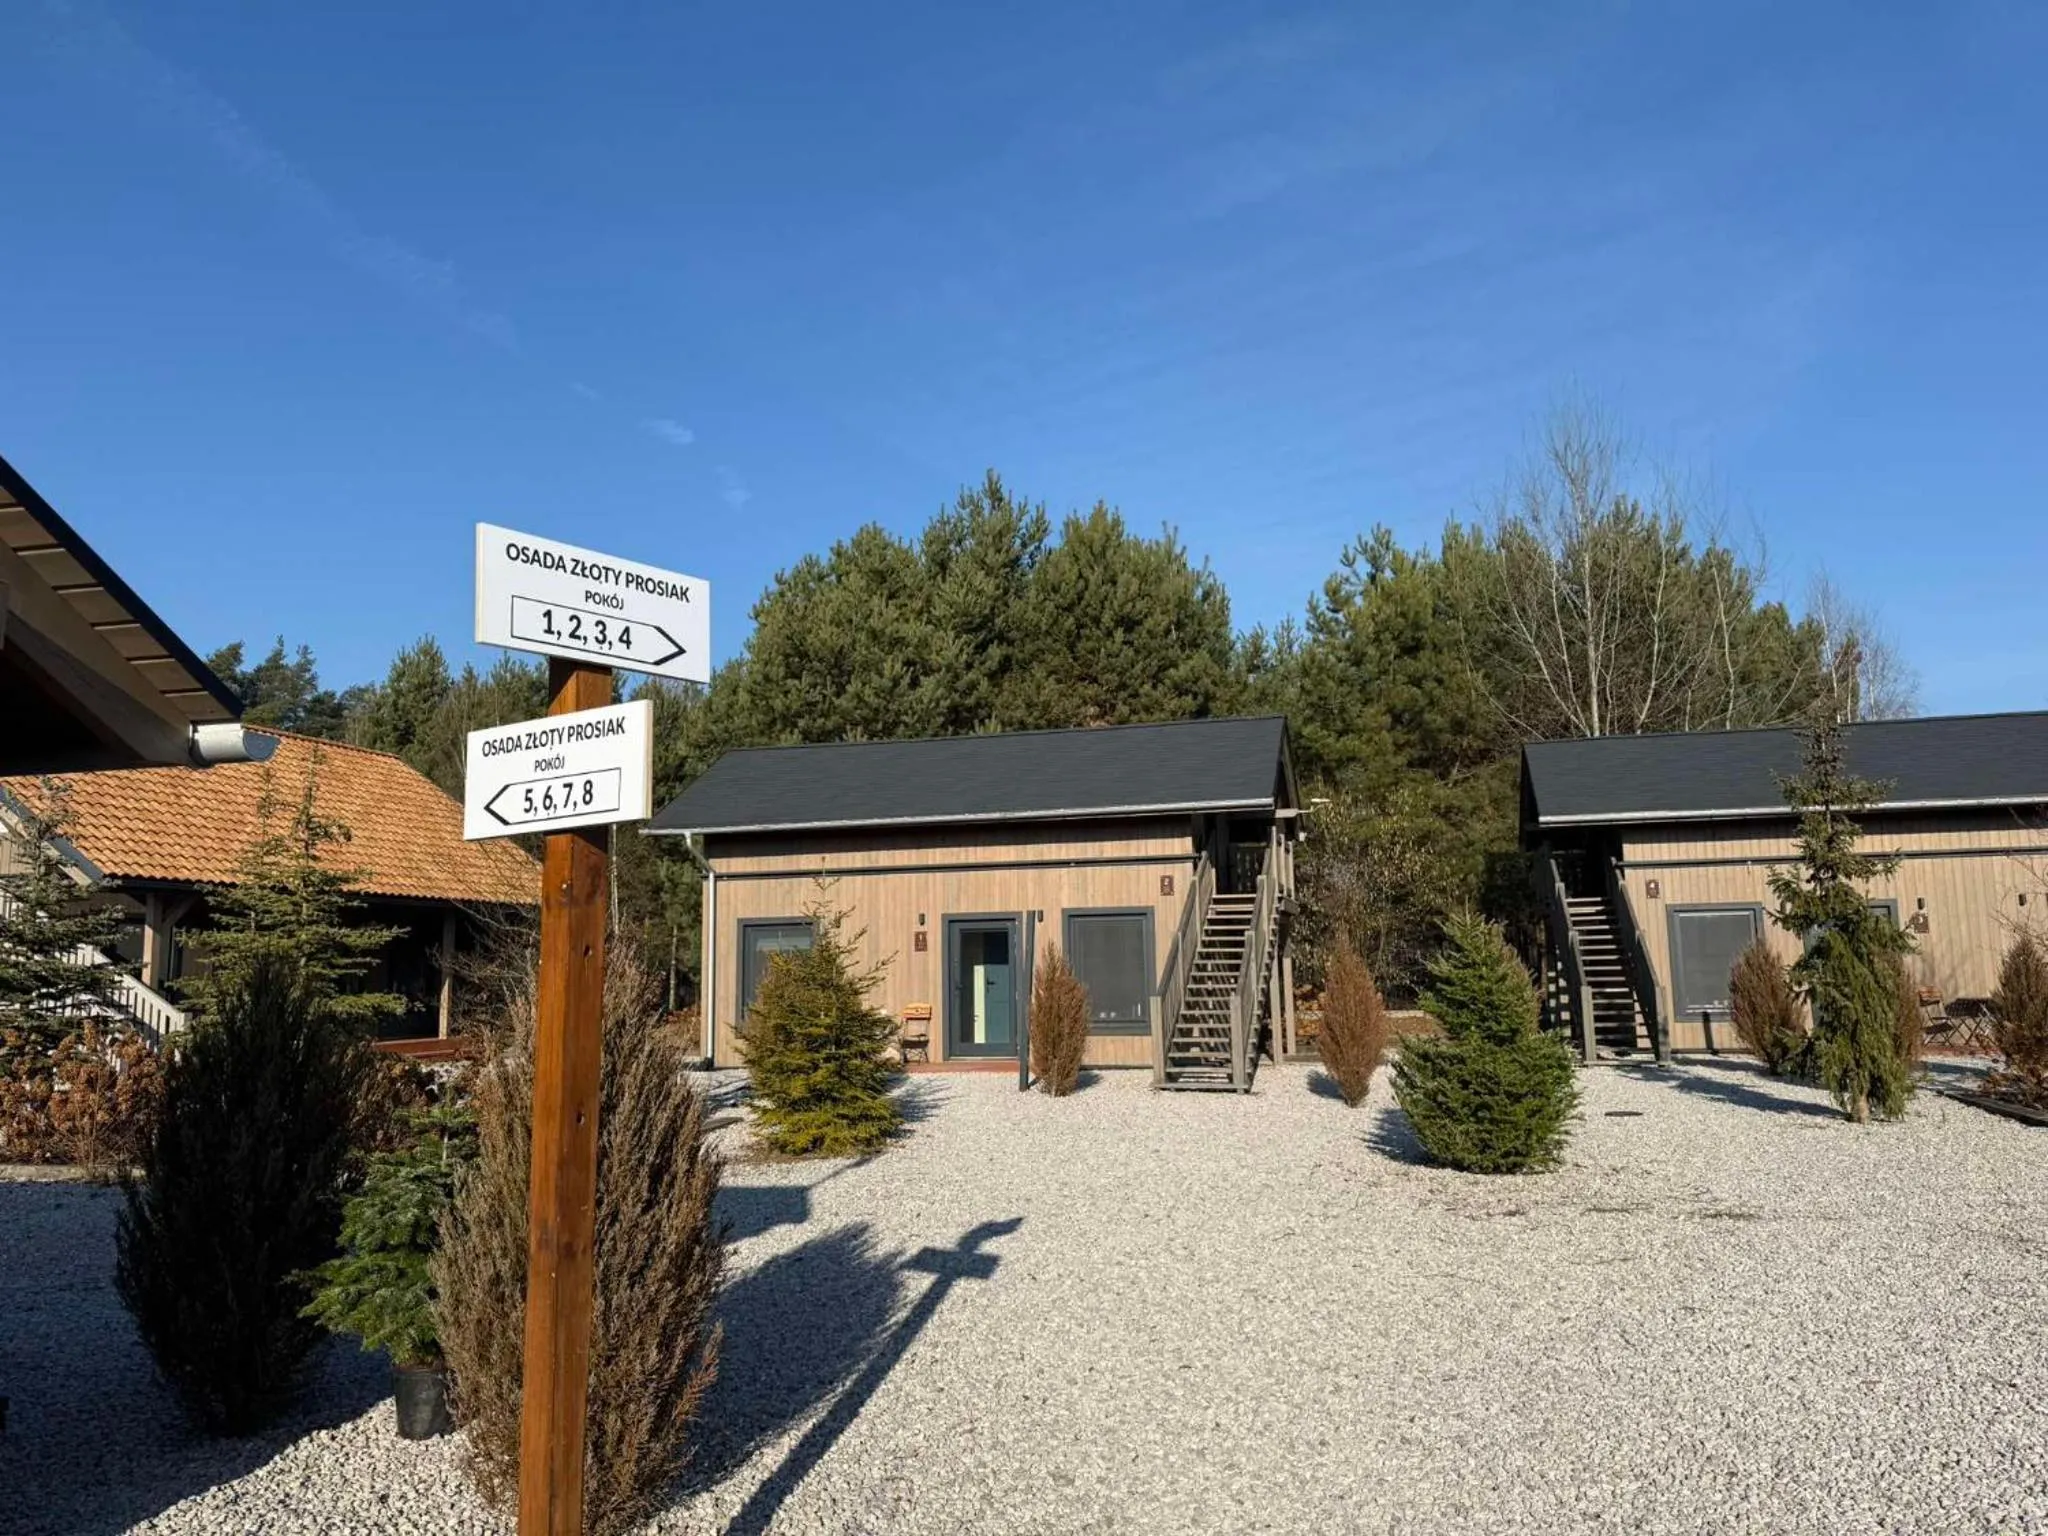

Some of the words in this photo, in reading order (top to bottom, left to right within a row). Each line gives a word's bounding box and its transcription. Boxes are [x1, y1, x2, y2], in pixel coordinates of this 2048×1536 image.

[505, 543, 568, 573] OSADA
[570, 558, 621, 585] ZŁOTY
[625, 572, 690, 603] PROSIAK
[585, 590, 624, 611] POKÓJ
[482, 736, 522, 757] OSADA
[525, 727, 564, 748] ZŁOTY
[567, 716, 626, 740] PROSIAK
[534, 754, 565, 772] POKÓJ
